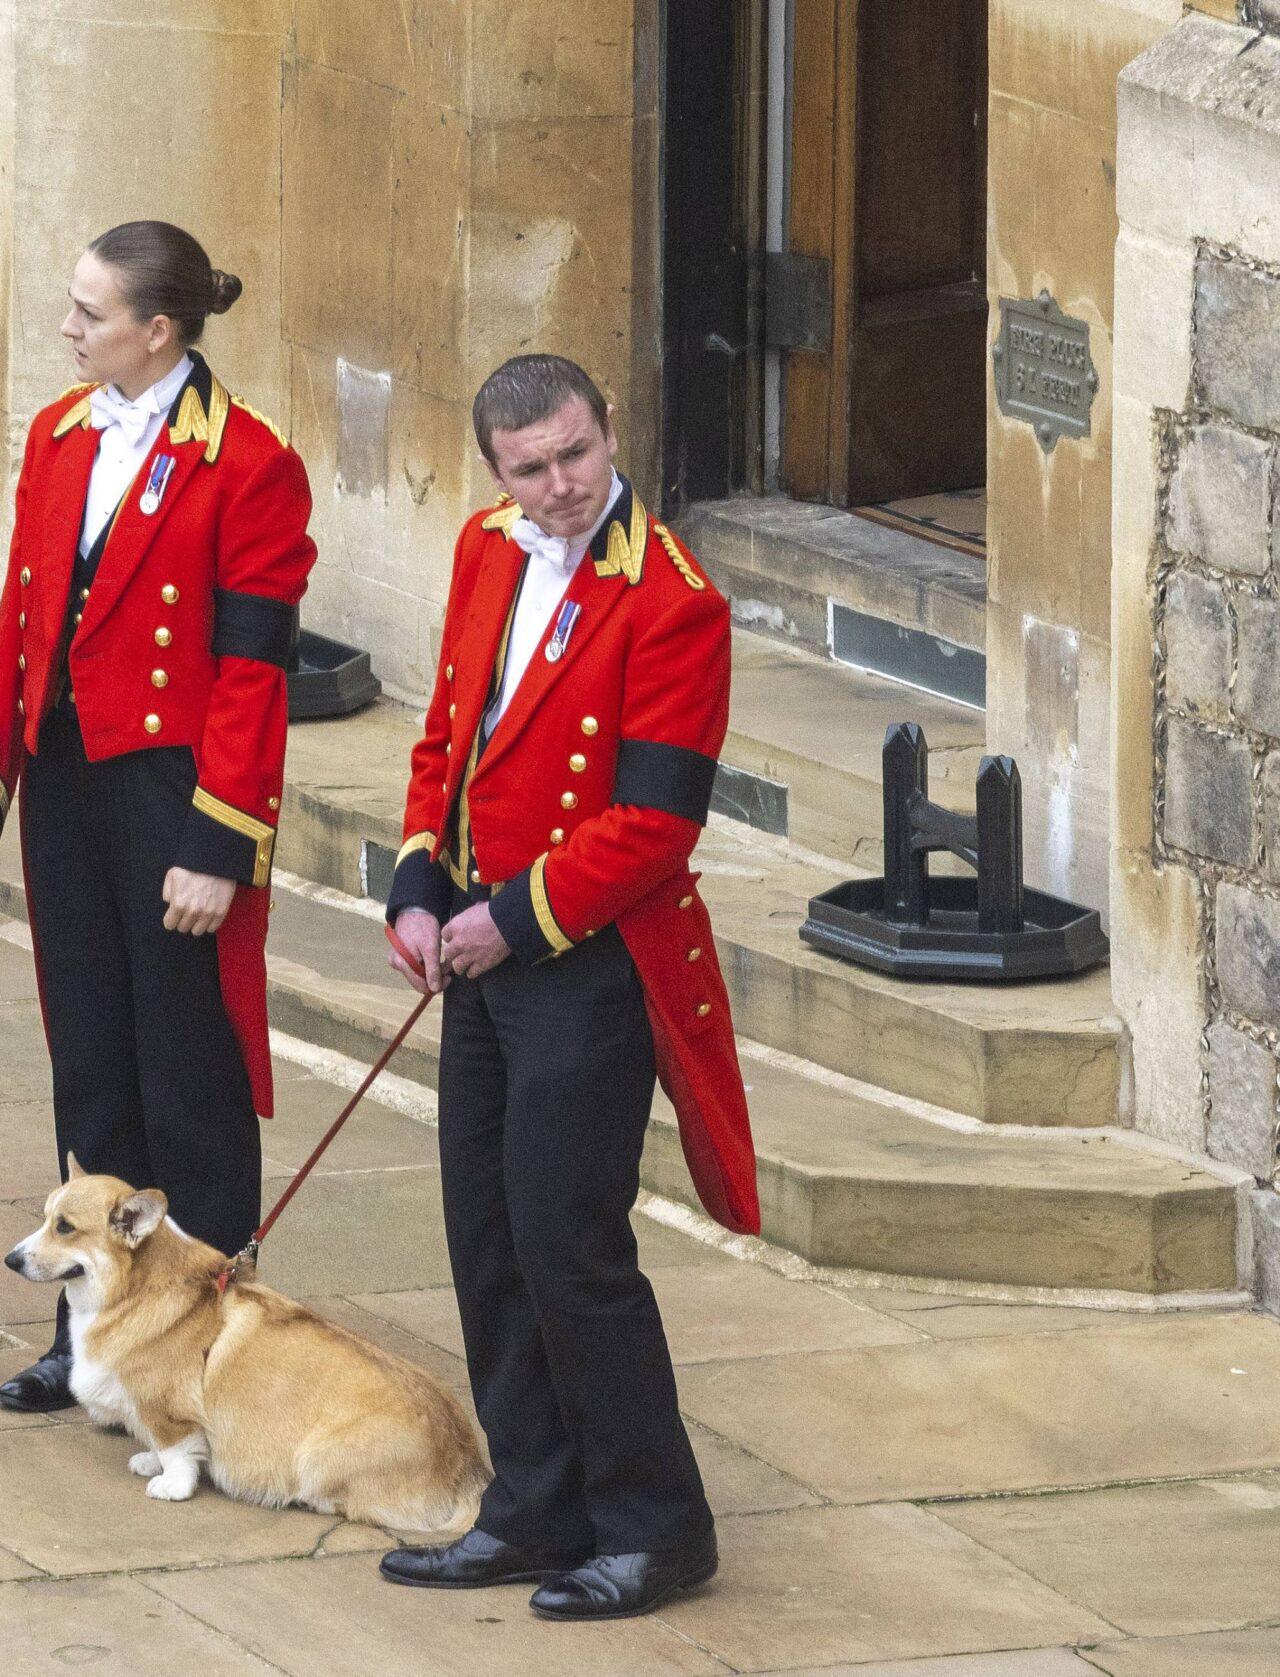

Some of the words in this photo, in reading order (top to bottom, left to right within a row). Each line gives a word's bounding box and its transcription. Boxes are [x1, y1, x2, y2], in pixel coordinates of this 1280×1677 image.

[1010, 324, 1043, 359] FIRE
[1048, 334, 1086, 371] PLUG
[1041, 372, 1081, 407] FEET
